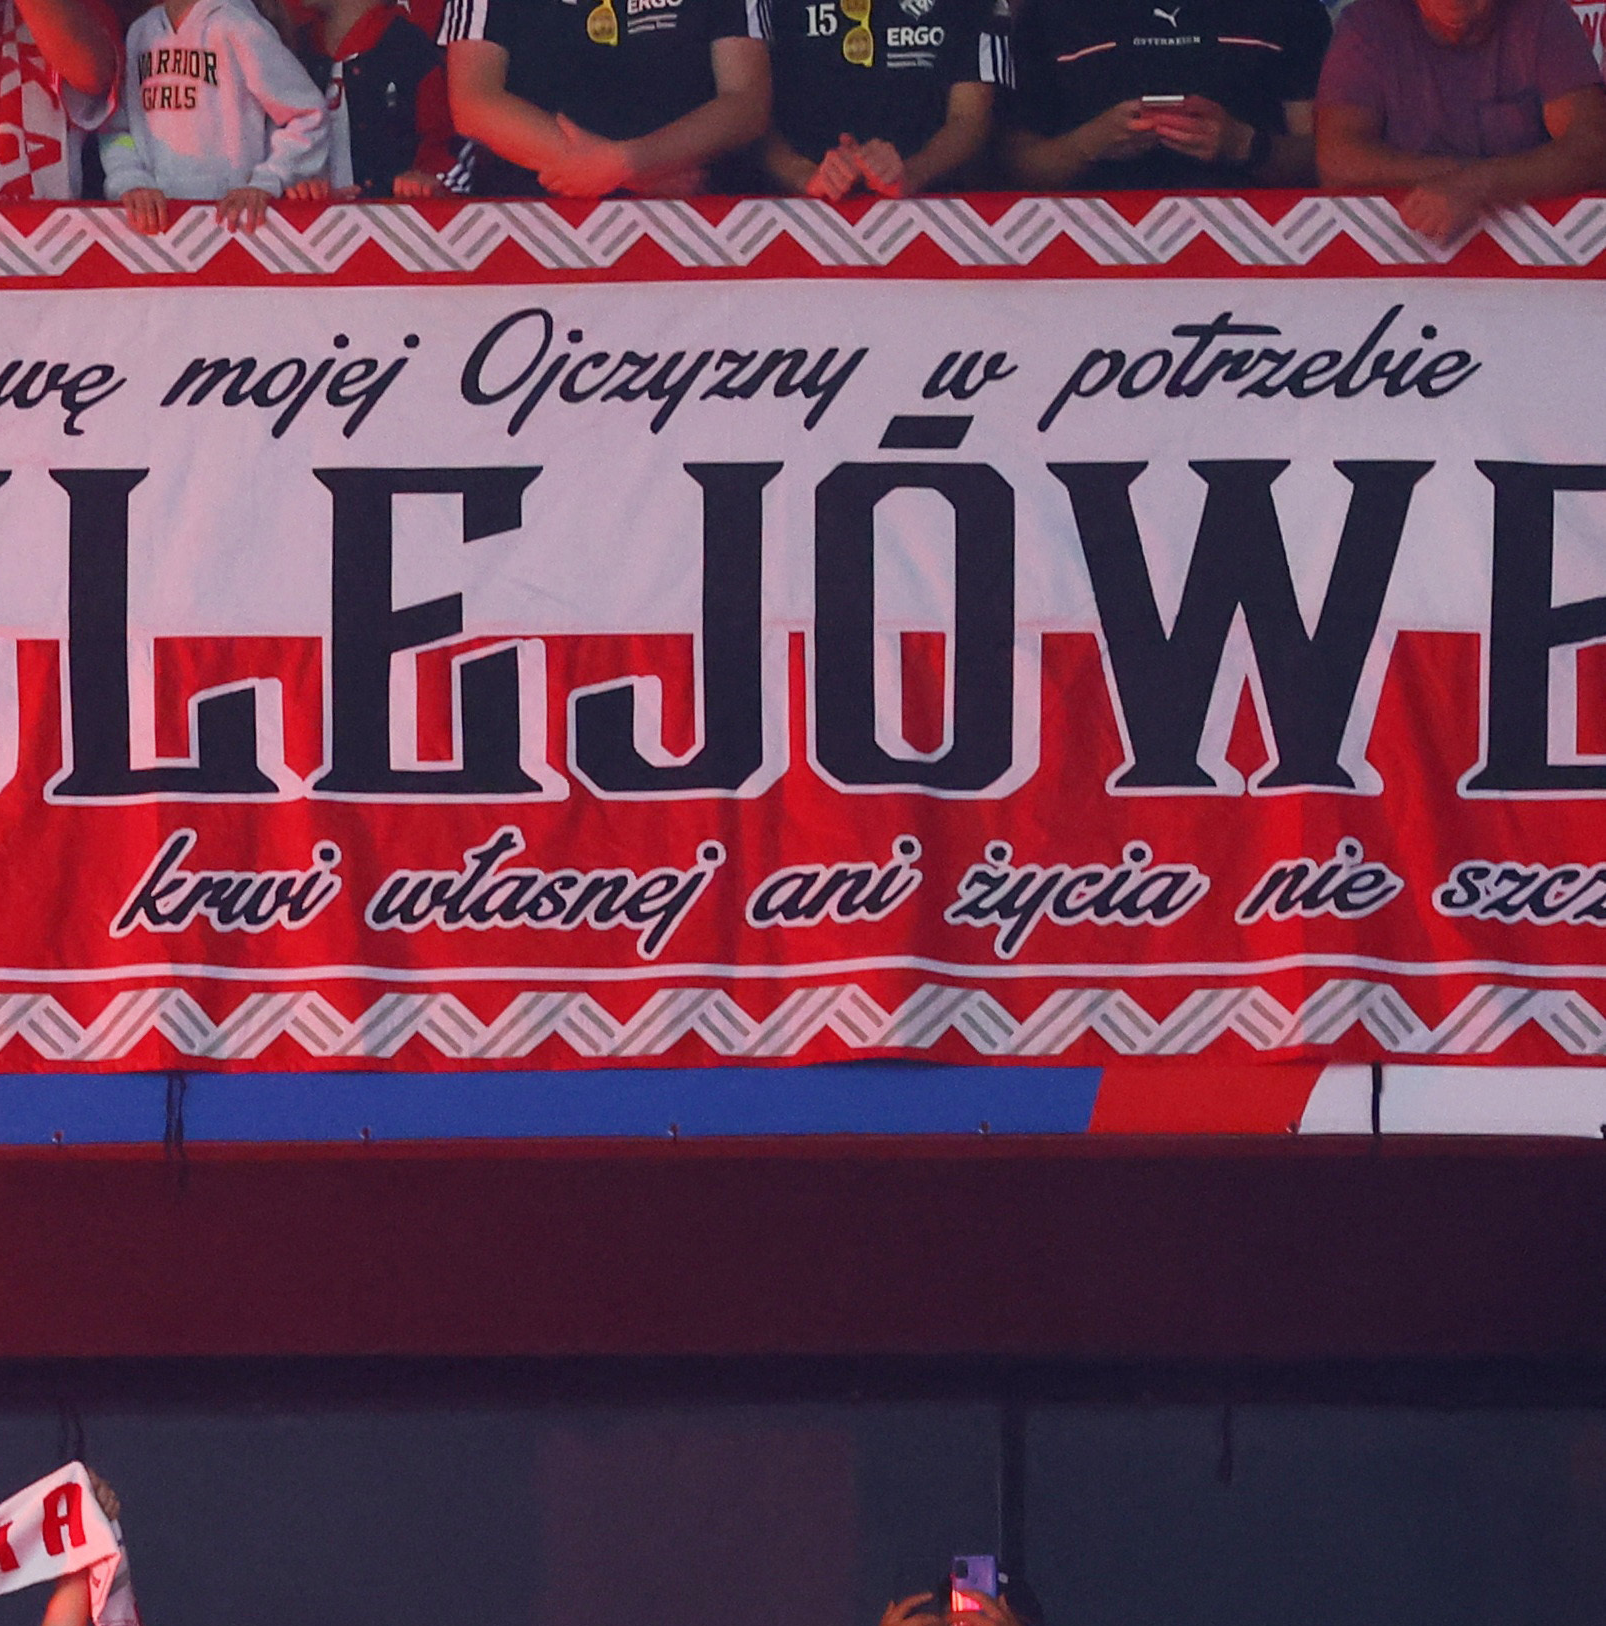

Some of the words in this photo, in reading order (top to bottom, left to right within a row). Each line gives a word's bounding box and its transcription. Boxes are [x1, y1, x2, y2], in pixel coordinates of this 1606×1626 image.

[805, 3, 838, 37] 15
[887, 26, 945, 47] ERGO
[142, 85, 196, 113] GIRLS
[159, 332, 420, 440] mojej
[458, 307, 868, 436] Ojczyzny
[920, 352, 1018, 402] w
[1037, 304, 1483, 433] potrzebie
[110, 826, 343, 938] krwi
[364, 824, 727, 958] własnej
[747, 836, 925, 926] ani
[945, 840, 1210, 957] życia
[1236, 837, 1404, 924] nie
